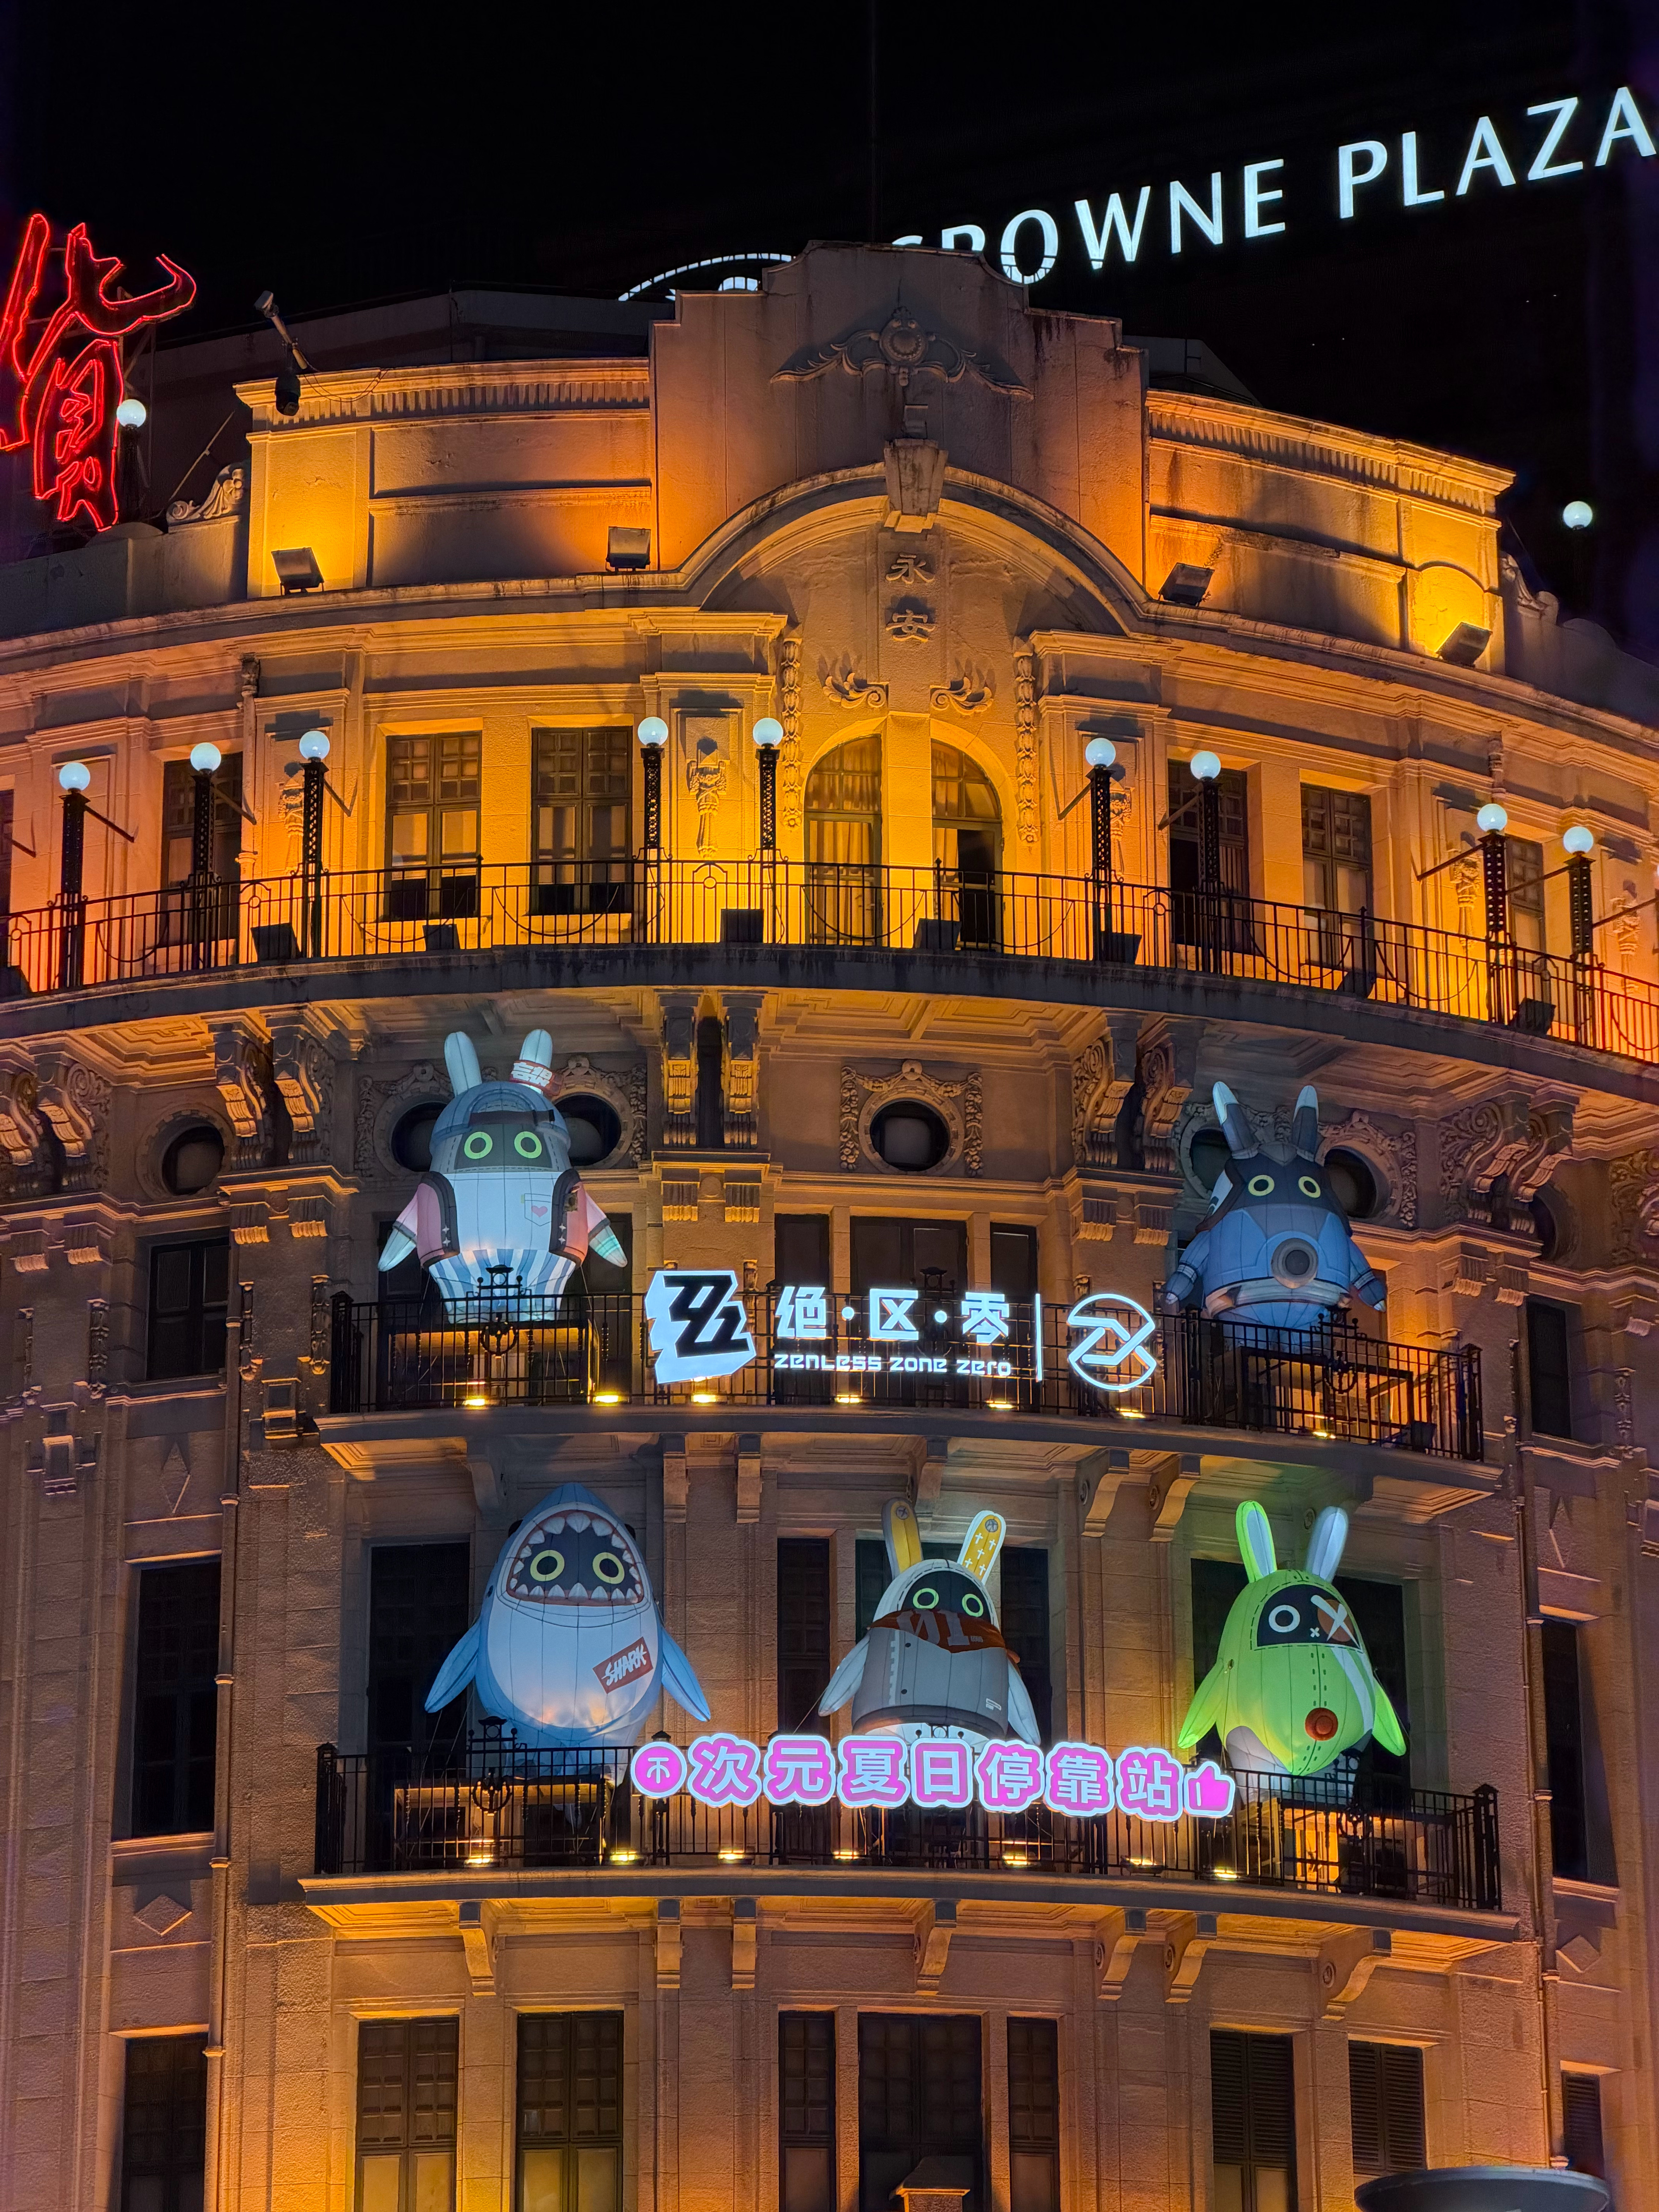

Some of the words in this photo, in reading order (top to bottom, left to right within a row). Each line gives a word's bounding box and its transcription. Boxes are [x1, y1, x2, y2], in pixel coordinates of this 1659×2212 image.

[892, 158, 1286, 285] OWNE
[1338, 86, 1657, 219] PLAZA
[885, 551, 936, 642] 永安
[601, 1643, 647, 1686] SHARK
[697, 1743, 1174, 1811] 次元夏日停靠站
